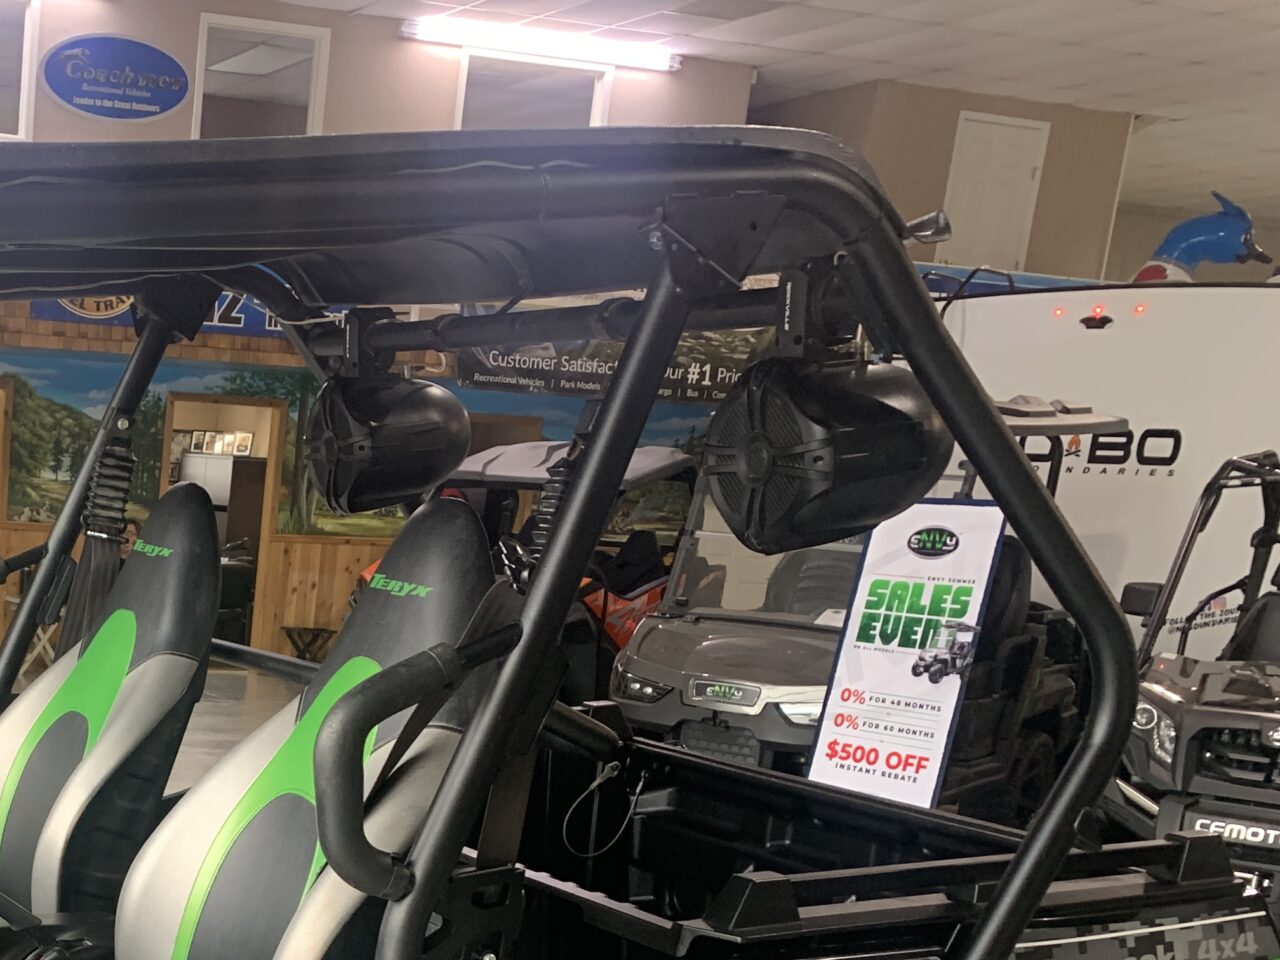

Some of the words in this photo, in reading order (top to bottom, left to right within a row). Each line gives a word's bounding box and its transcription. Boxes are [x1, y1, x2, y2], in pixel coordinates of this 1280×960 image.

[489, 350, 558, 371] Customer
[687, 362, 712, 386] #1
[863, 578, 974, 619] SALES
[840, 687, 866, 705] 0%
[868, 695, 887, 704] FOR
[904, 701, 942, 713] MONTHS
[833, 712, 859, 730] 0%
[862, 721, 880, 730] FOR
[883, 725, 895, 733] 60
[897, 727, 935, 739] MONTHS
[825, 738, 880, 766] $500
[885, 751, 930, 775] OFF
[835, 762, 878, 776] INSTANT
[881, 771, 918, 784] REBATE
[1194, 819, 1280, 844] CFMOT
